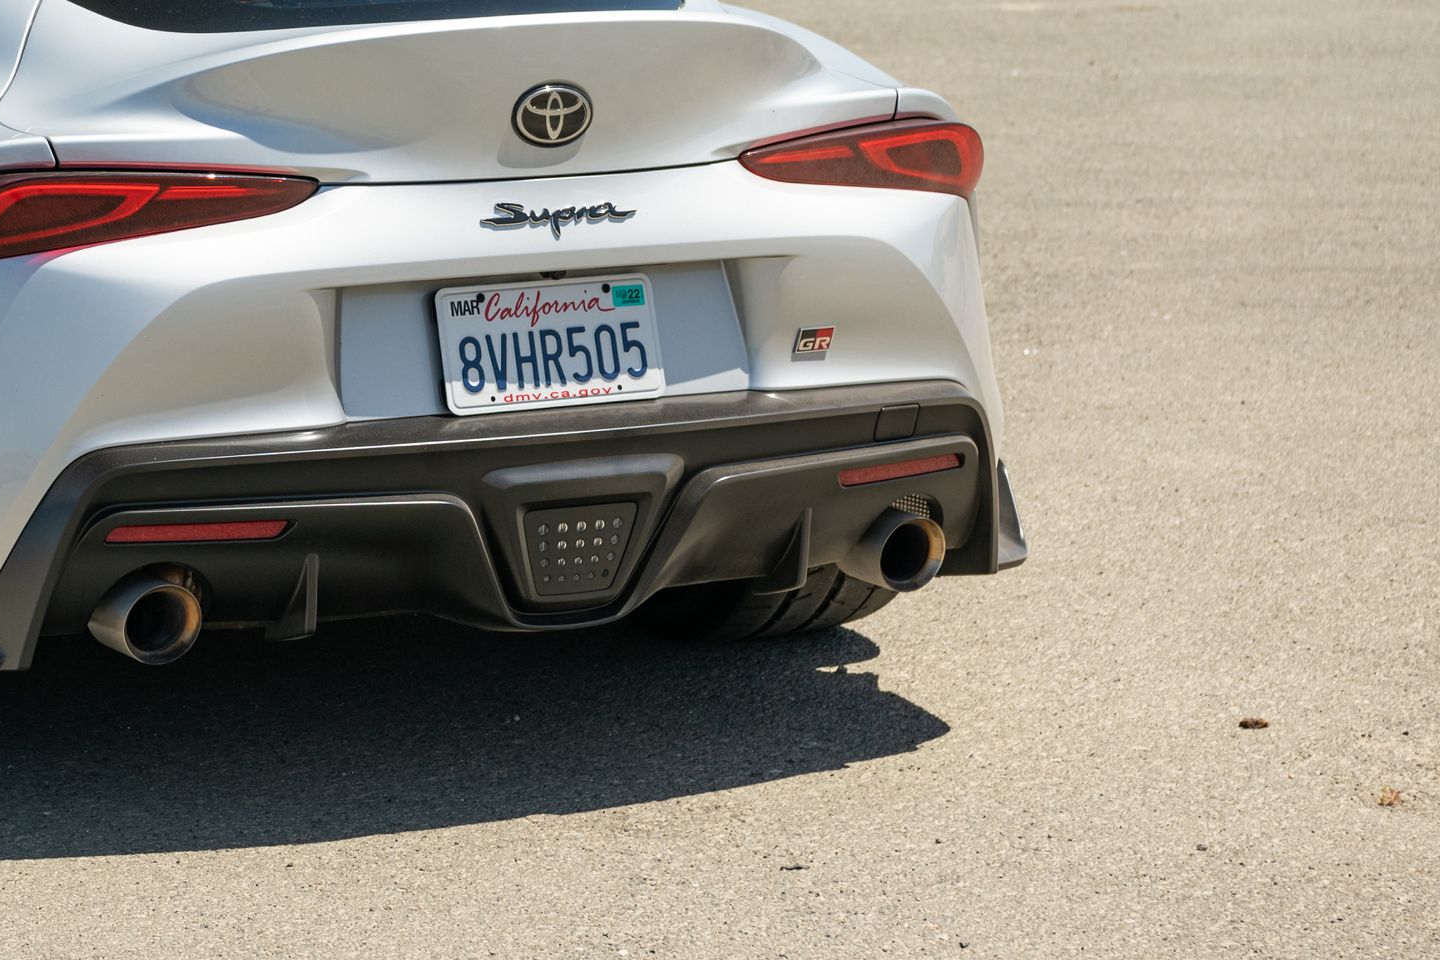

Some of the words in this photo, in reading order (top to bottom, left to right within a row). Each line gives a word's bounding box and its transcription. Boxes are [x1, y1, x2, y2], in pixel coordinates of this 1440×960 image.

[479, 201, 637, 240] Supra
[627, 288, 641, 299] 22
[450, 300, 480, 316] MAR
[484, 289, 615, 327] California
[799, 336, 830, 350] GR
[460, 321, 648, 394] 8VHR505
[503, 386, 612, 404] dmv.ca.gov
